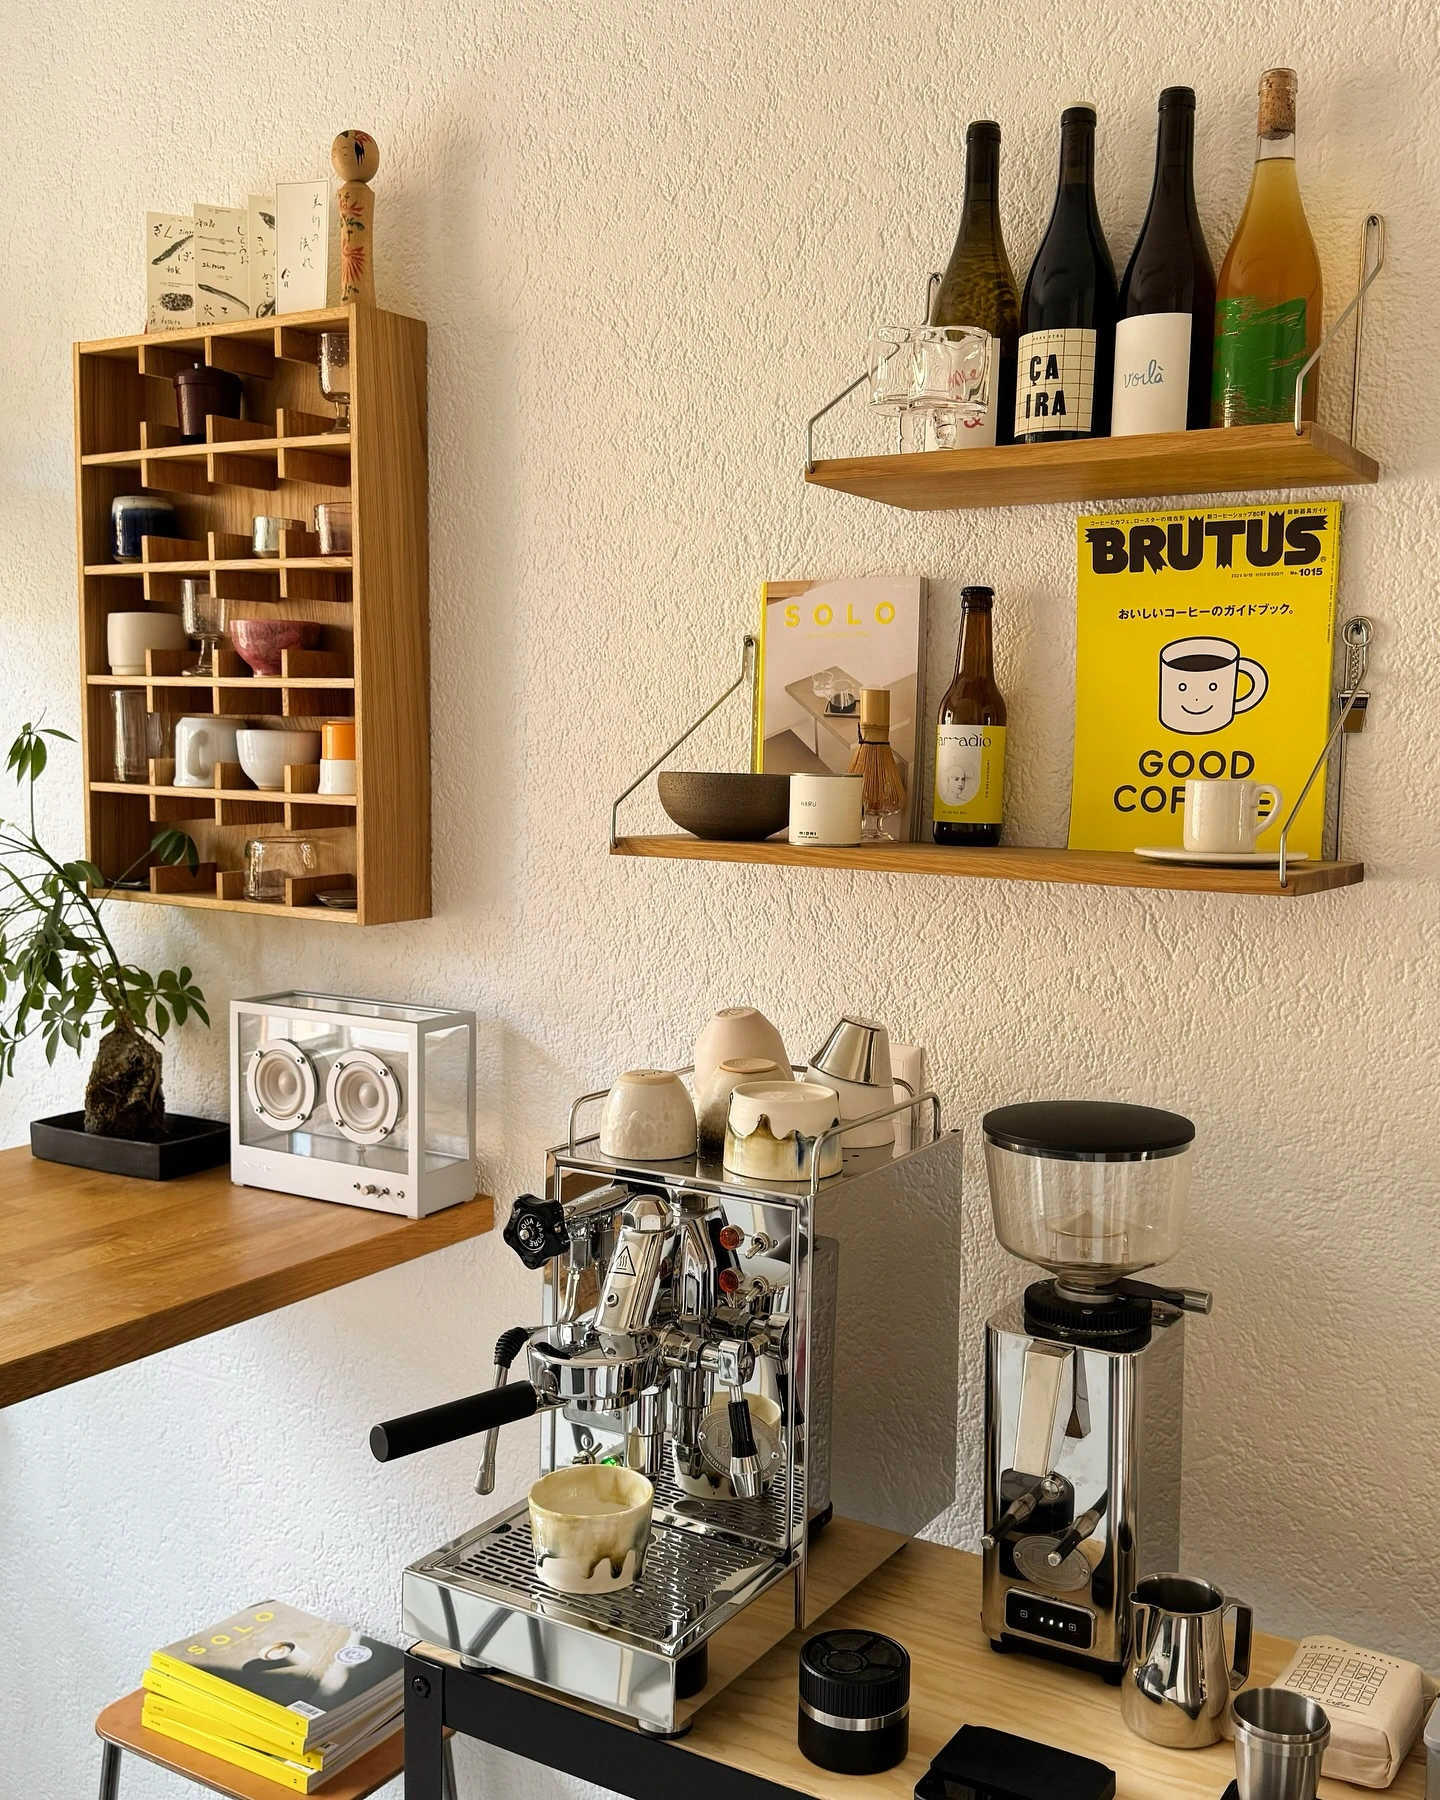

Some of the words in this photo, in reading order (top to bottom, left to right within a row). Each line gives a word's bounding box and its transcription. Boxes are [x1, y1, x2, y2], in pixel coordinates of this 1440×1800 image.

[1029, 353, 1060, 387] ÇA
[1123, 358, 1165, 389] voilà
[1025, 389, 1067, 419] IRA
[1084, 510, 1329, 575] BRUTUS
[783, 600, 896, 628] SOLO
[1118, 602, 1294, 620] おいしいコーヒーのガイドブック。
[1138, 749, 1256, 779] GOOD
[800, 800, 817, 808] HARU
[1113, 784, 1271, 818] COF
[186, 1611, 275, 1656] SOLO
